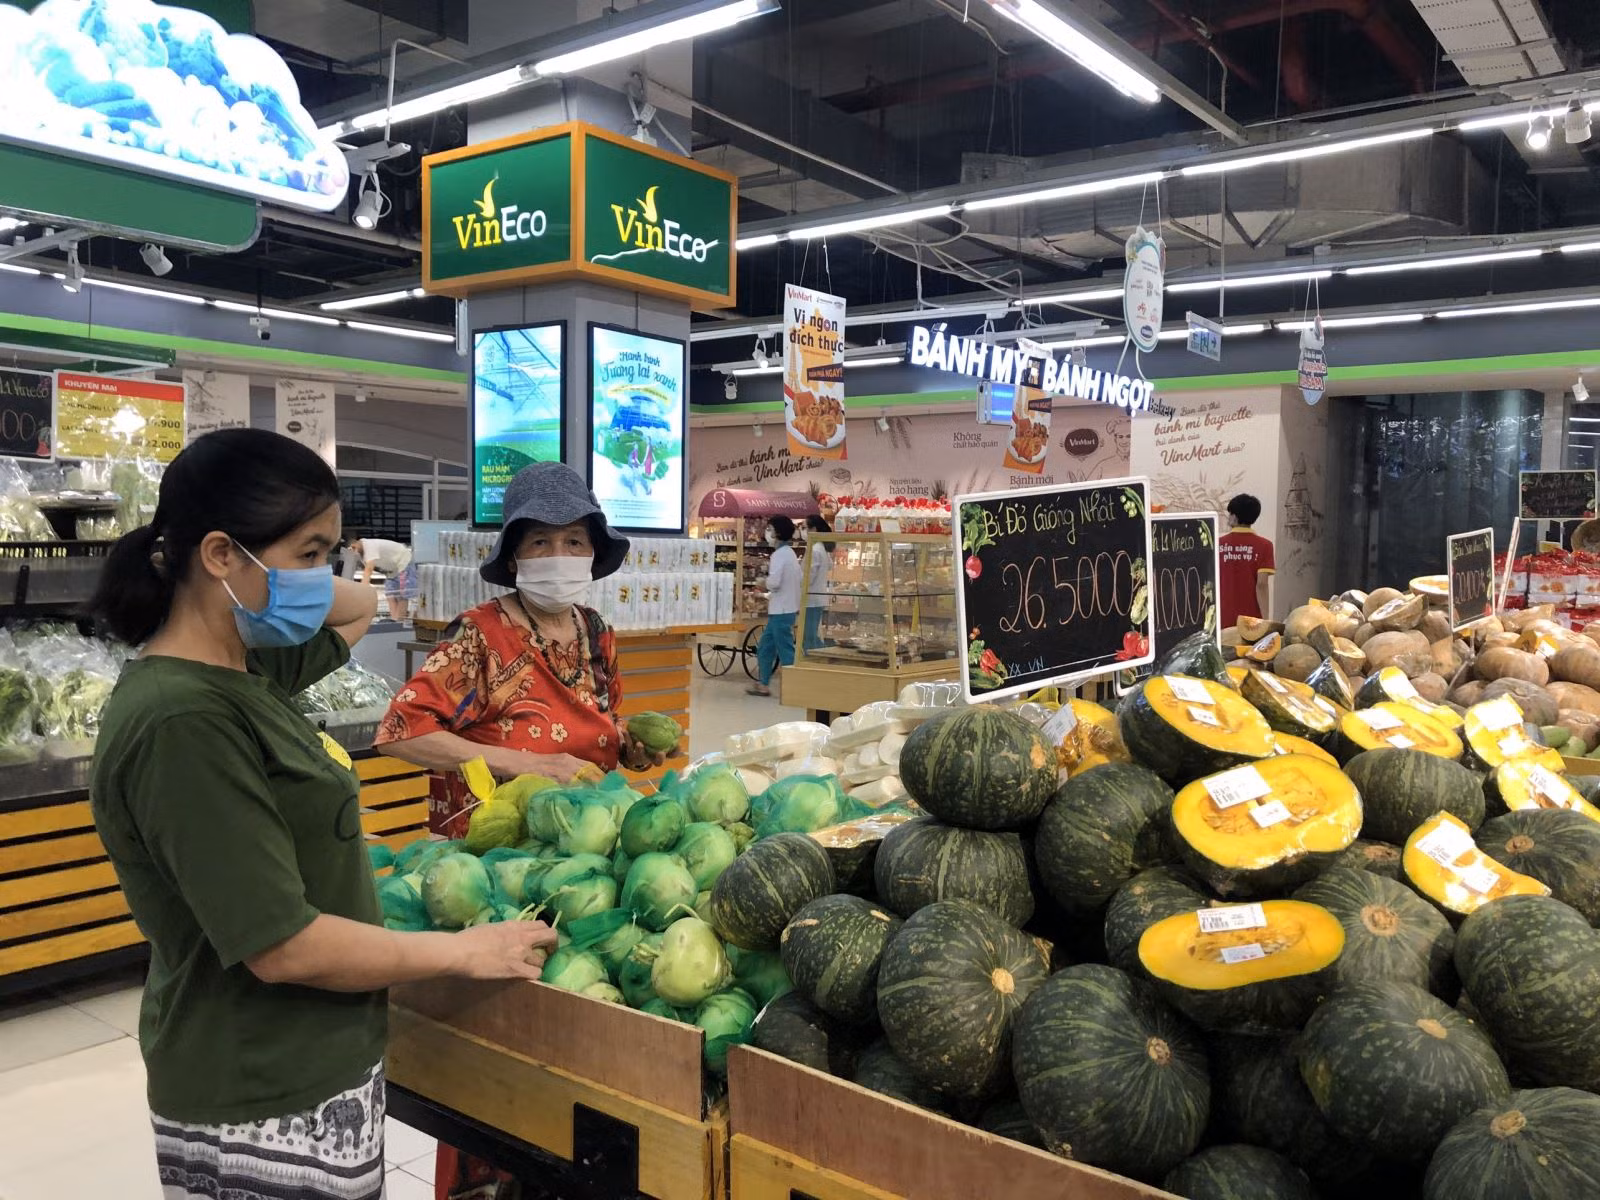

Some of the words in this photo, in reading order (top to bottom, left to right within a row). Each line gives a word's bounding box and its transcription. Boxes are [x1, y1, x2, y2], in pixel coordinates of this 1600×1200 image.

[452, 204, 547, 250] VinEco
[610, 203, 707, 263] VinEco
[794, 308, 806, 330] Vị
[810, 315, 838, 332] ngon
[789, 326, 814, 348] đích
[818, 335, 844, 356] thực
[911, 322, 988, 378] BÁNH
[1042, 354, 1101, 401] BÁNH
[1101, 374, 1154, 417] NGỌT
[1204, 406, 1252, 431] baguette
[713, 491, 726, 508] S
[983, 501, 1005, 538] Bí
[1033, 496, 1076, 545] Giống
